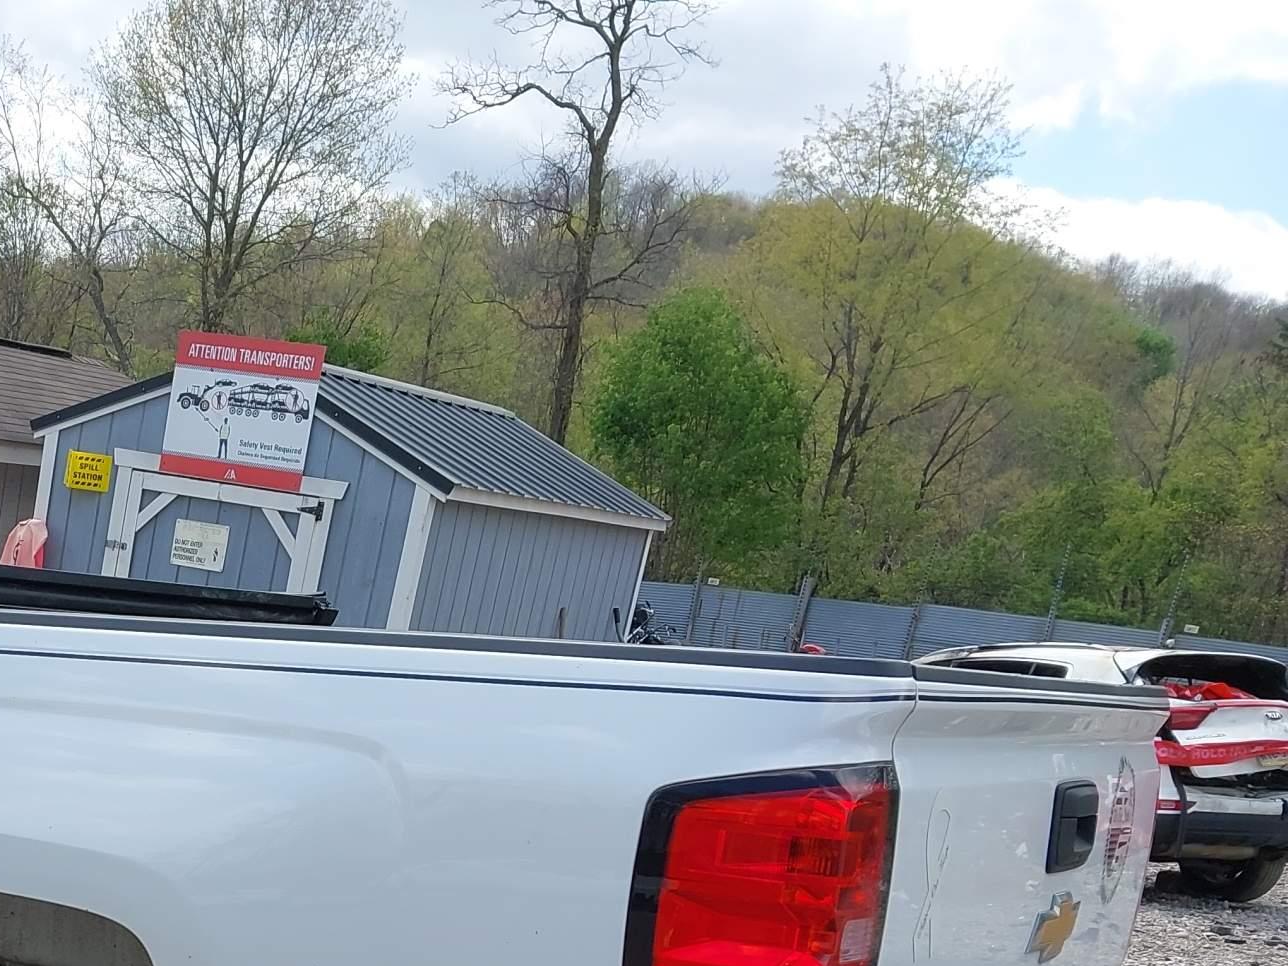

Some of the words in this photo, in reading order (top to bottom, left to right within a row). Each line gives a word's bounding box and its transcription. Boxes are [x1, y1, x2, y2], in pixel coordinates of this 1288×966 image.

[188, 343, 237, 362] ATTENTION
[239, 348, 315, 371] TRANSPORTERS!
[239, 439, 258, 450] Safety
[274, 443, 302, 455] Required
[79, 462, 99, 471] SPILL
[73, 471, 102, 481] STATION
